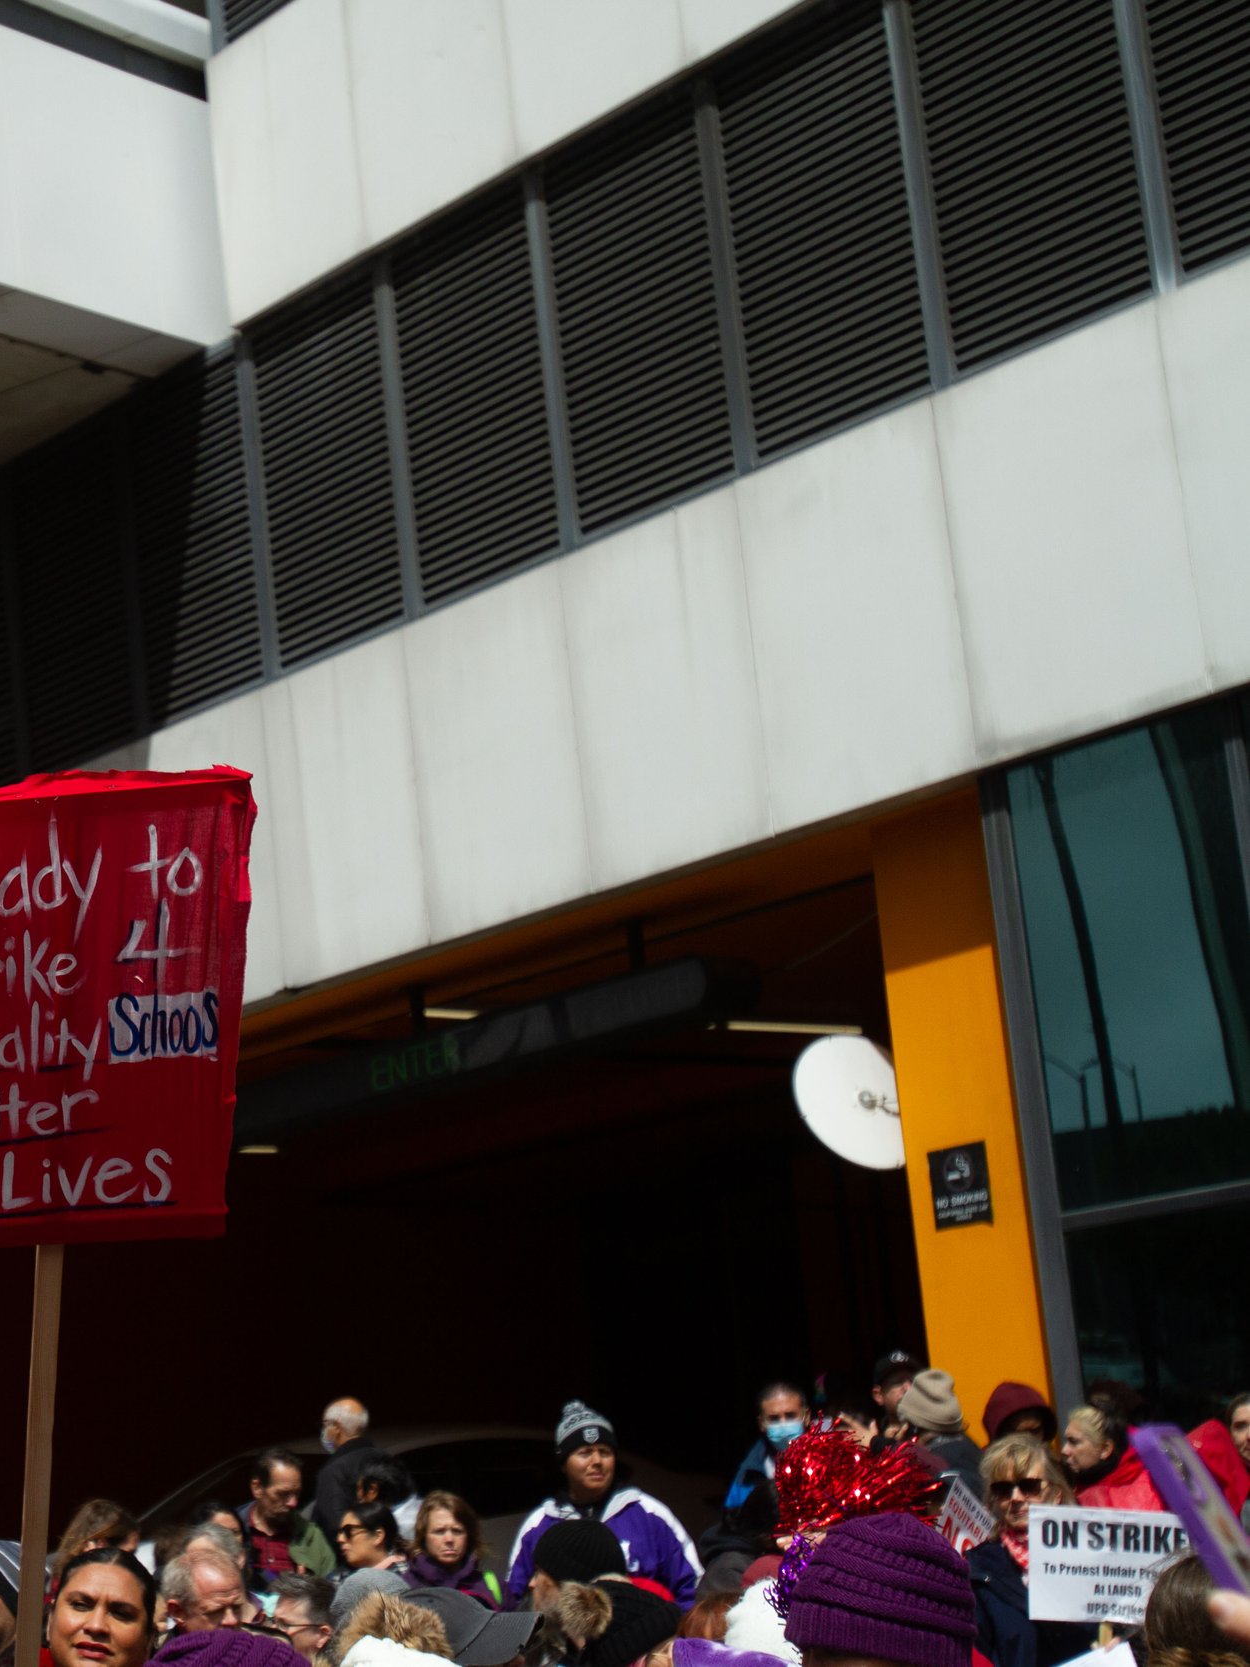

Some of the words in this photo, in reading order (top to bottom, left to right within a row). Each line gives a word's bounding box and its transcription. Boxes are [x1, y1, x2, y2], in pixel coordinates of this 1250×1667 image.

[127, 825, 203, 900] to
[116, 899, 196, 980] 4
[109, 988, 219, 1057] Schoos
[1, 1148, 173, 1210] Lives
[949, 1497, 986, 1542] EQUITABL
[1041, 1519, 1078, 1550] ON
[1043, 1562, 1056, 1575] To
[1059, 1563, 1100, 1577] Protest
[1102, 1565, 1137, 1578] Unfair
[1094, 1584, 1105, 1596] At
